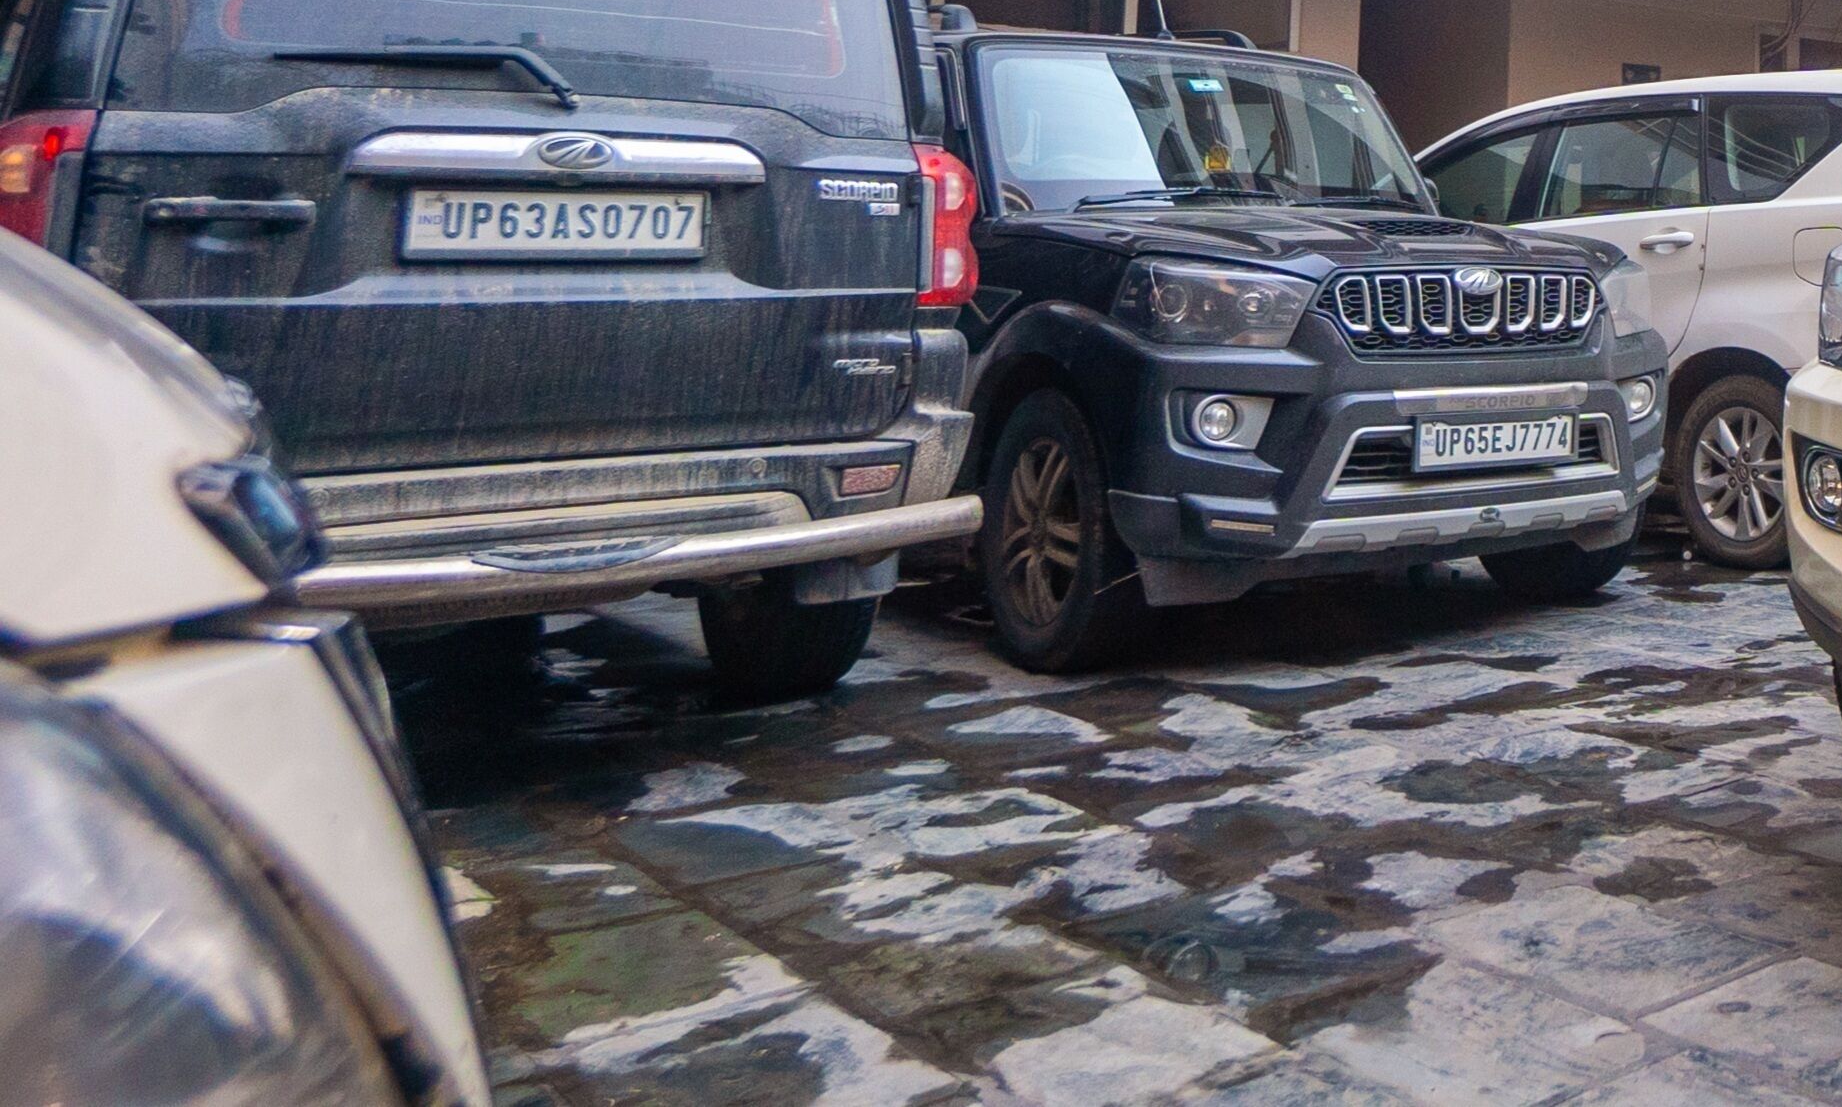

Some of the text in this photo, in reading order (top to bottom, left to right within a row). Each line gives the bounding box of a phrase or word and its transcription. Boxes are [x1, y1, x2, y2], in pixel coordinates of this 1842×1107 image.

[819, 179, 899, 202] SCORPIO
[442, 201, 696, 239] UP63AS0707
[1465, 394, 1536, 409] SCORPIO
[1435, 421, 1569, 457] UP65EJ7774
